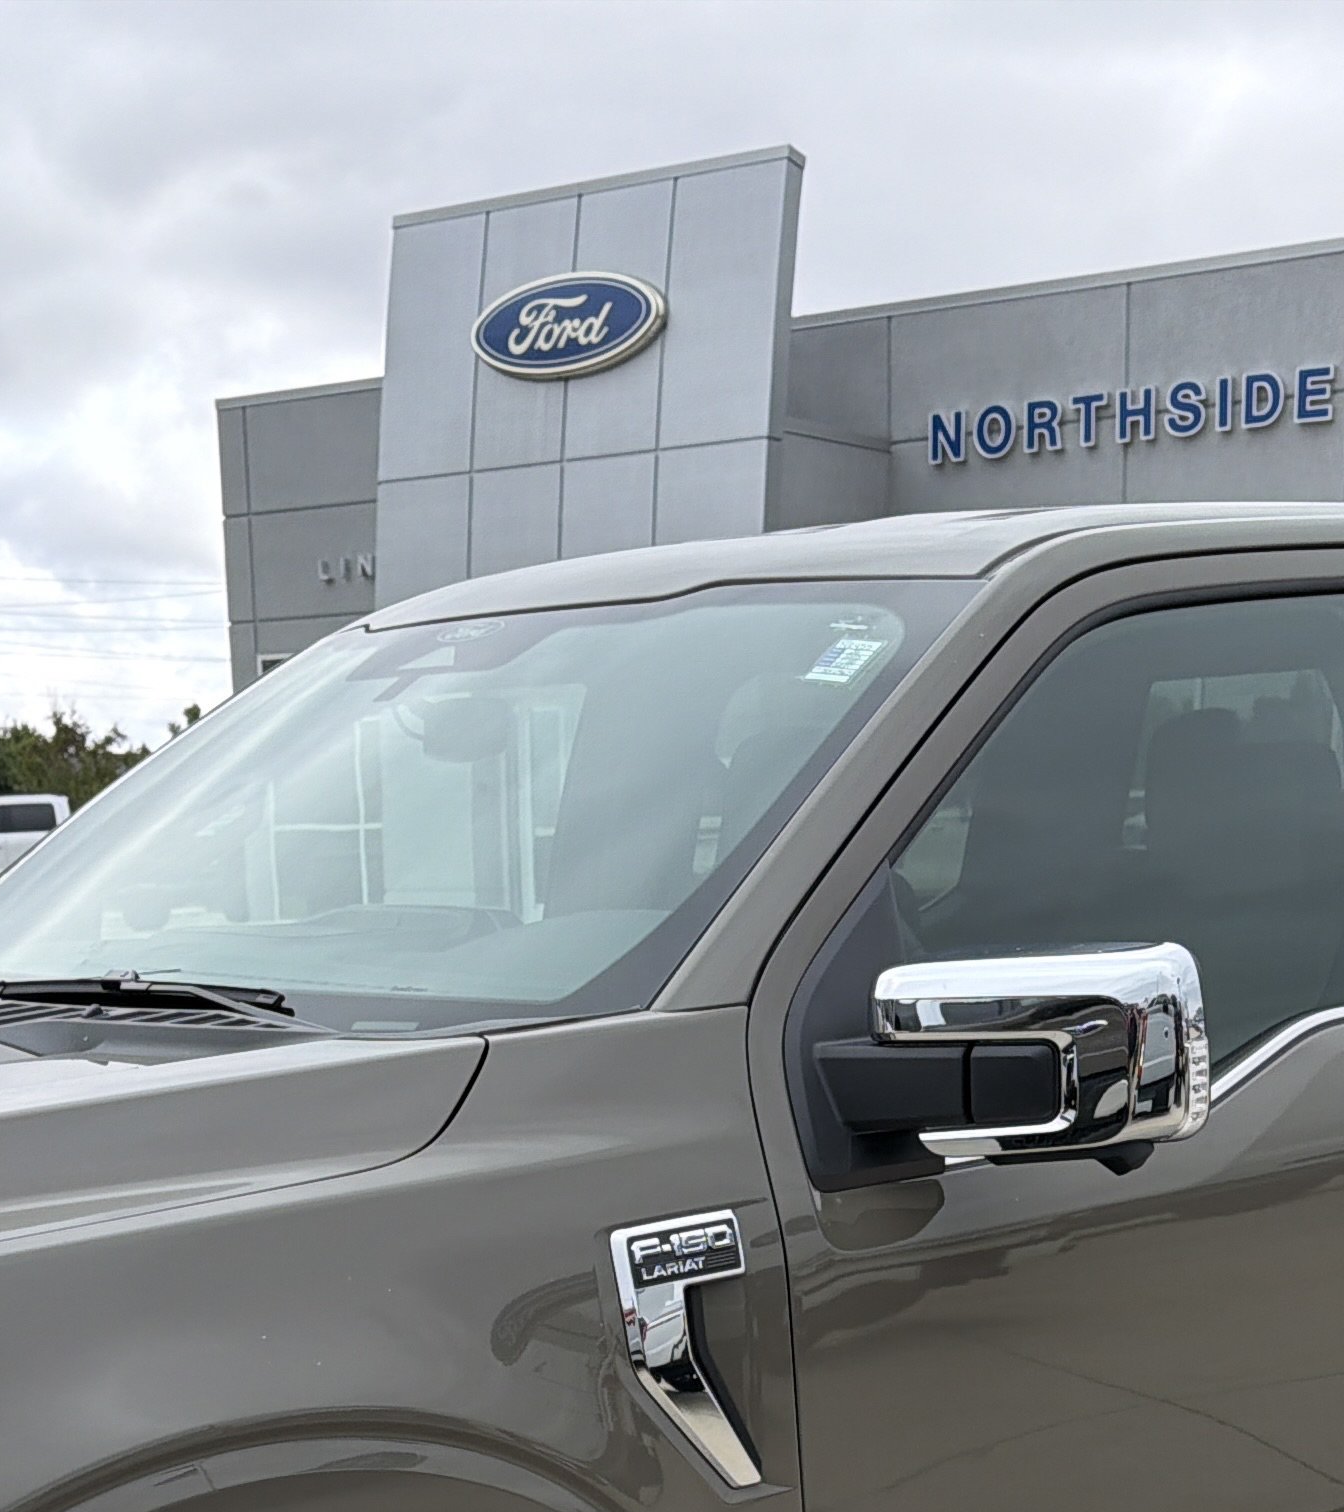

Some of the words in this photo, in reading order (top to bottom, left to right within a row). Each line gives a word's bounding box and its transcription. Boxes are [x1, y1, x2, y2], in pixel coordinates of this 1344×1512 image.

[508, 294, 613, 355] Ford
[927, 364, 1335, 466] NORTHSIDE
[630, 1223, 736, 1265] F-150
[641, 1256, 706, 1281] LARIAT
